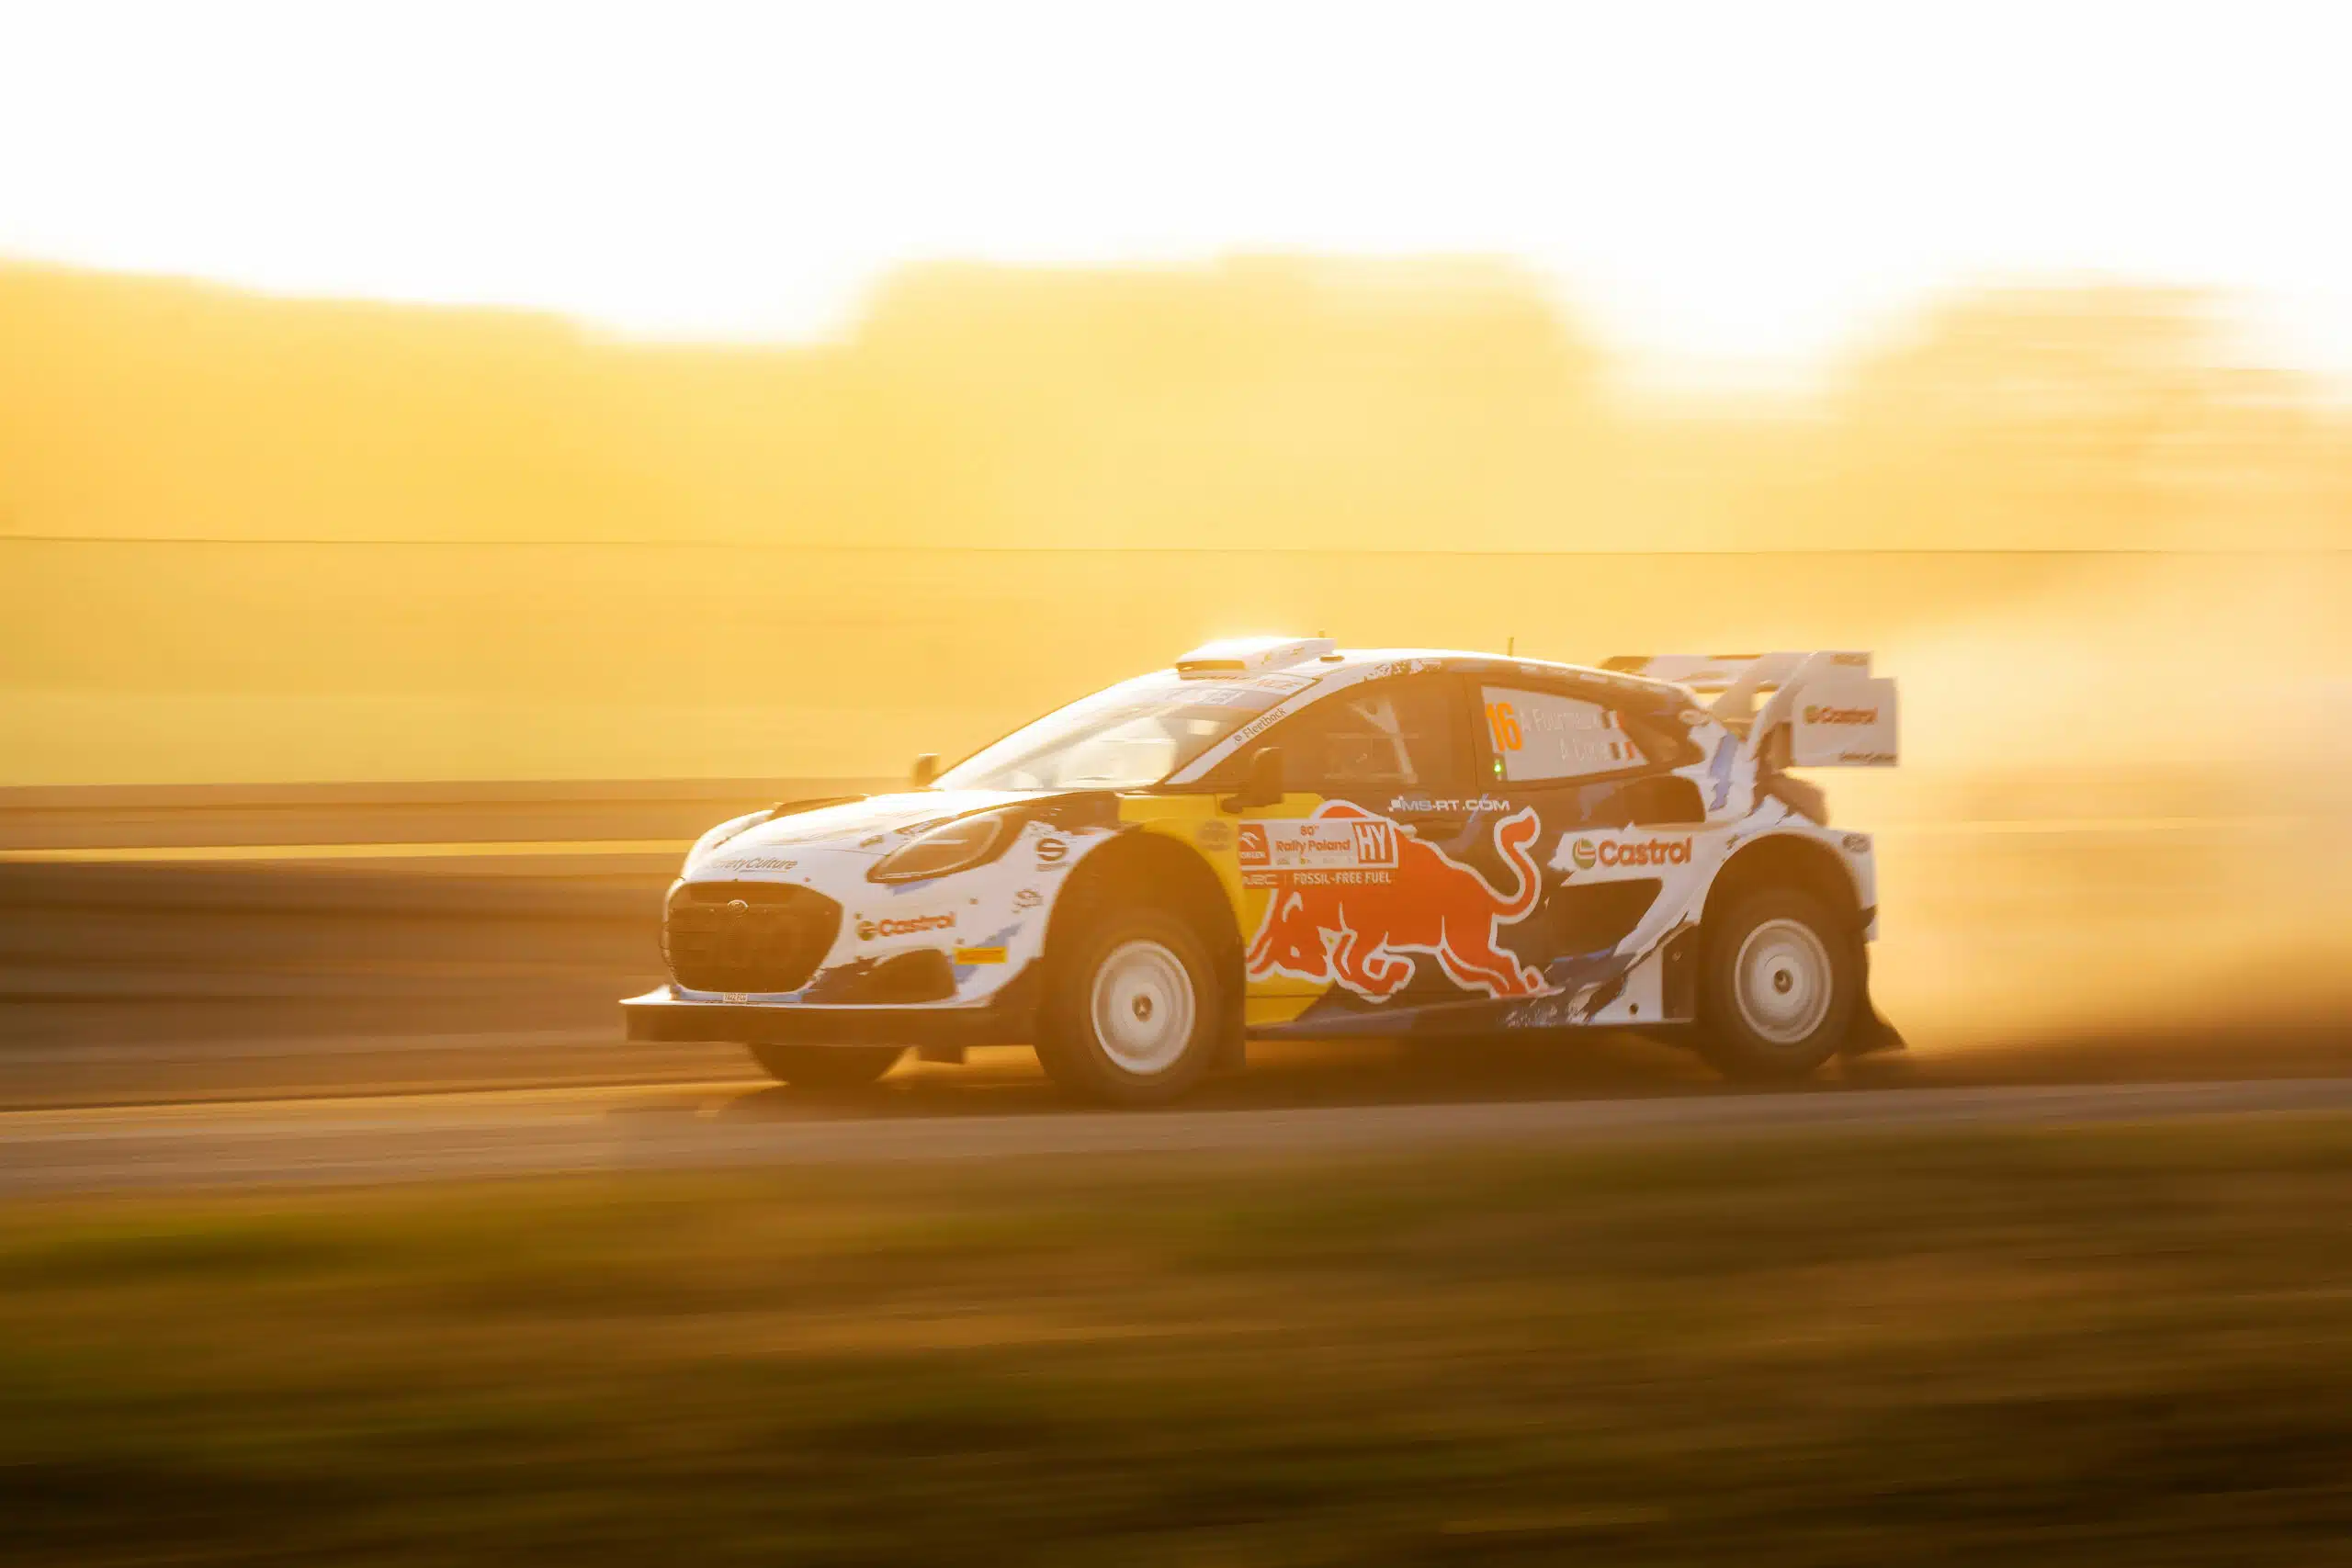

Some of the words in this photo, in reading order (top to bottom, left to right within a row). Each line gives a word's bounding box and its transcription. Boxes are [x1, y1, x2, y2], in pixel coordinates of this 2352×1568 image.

[1242, 707, 1287, 739] Fleetback
[1485, 702, 1522, 751] 16
[1275, 840, 1306, 854] Rally
[1308, 840, 1351, 852] Poland
[1355, 824, 1386, 861] HY
[1599, 836, 1692, 868] Castrol
[1293, 872, 1364, 885] FOSSIL-FREE
[1365, 871, 1392, 885] FUEL
[879, 911, 956, 937] Castrol
